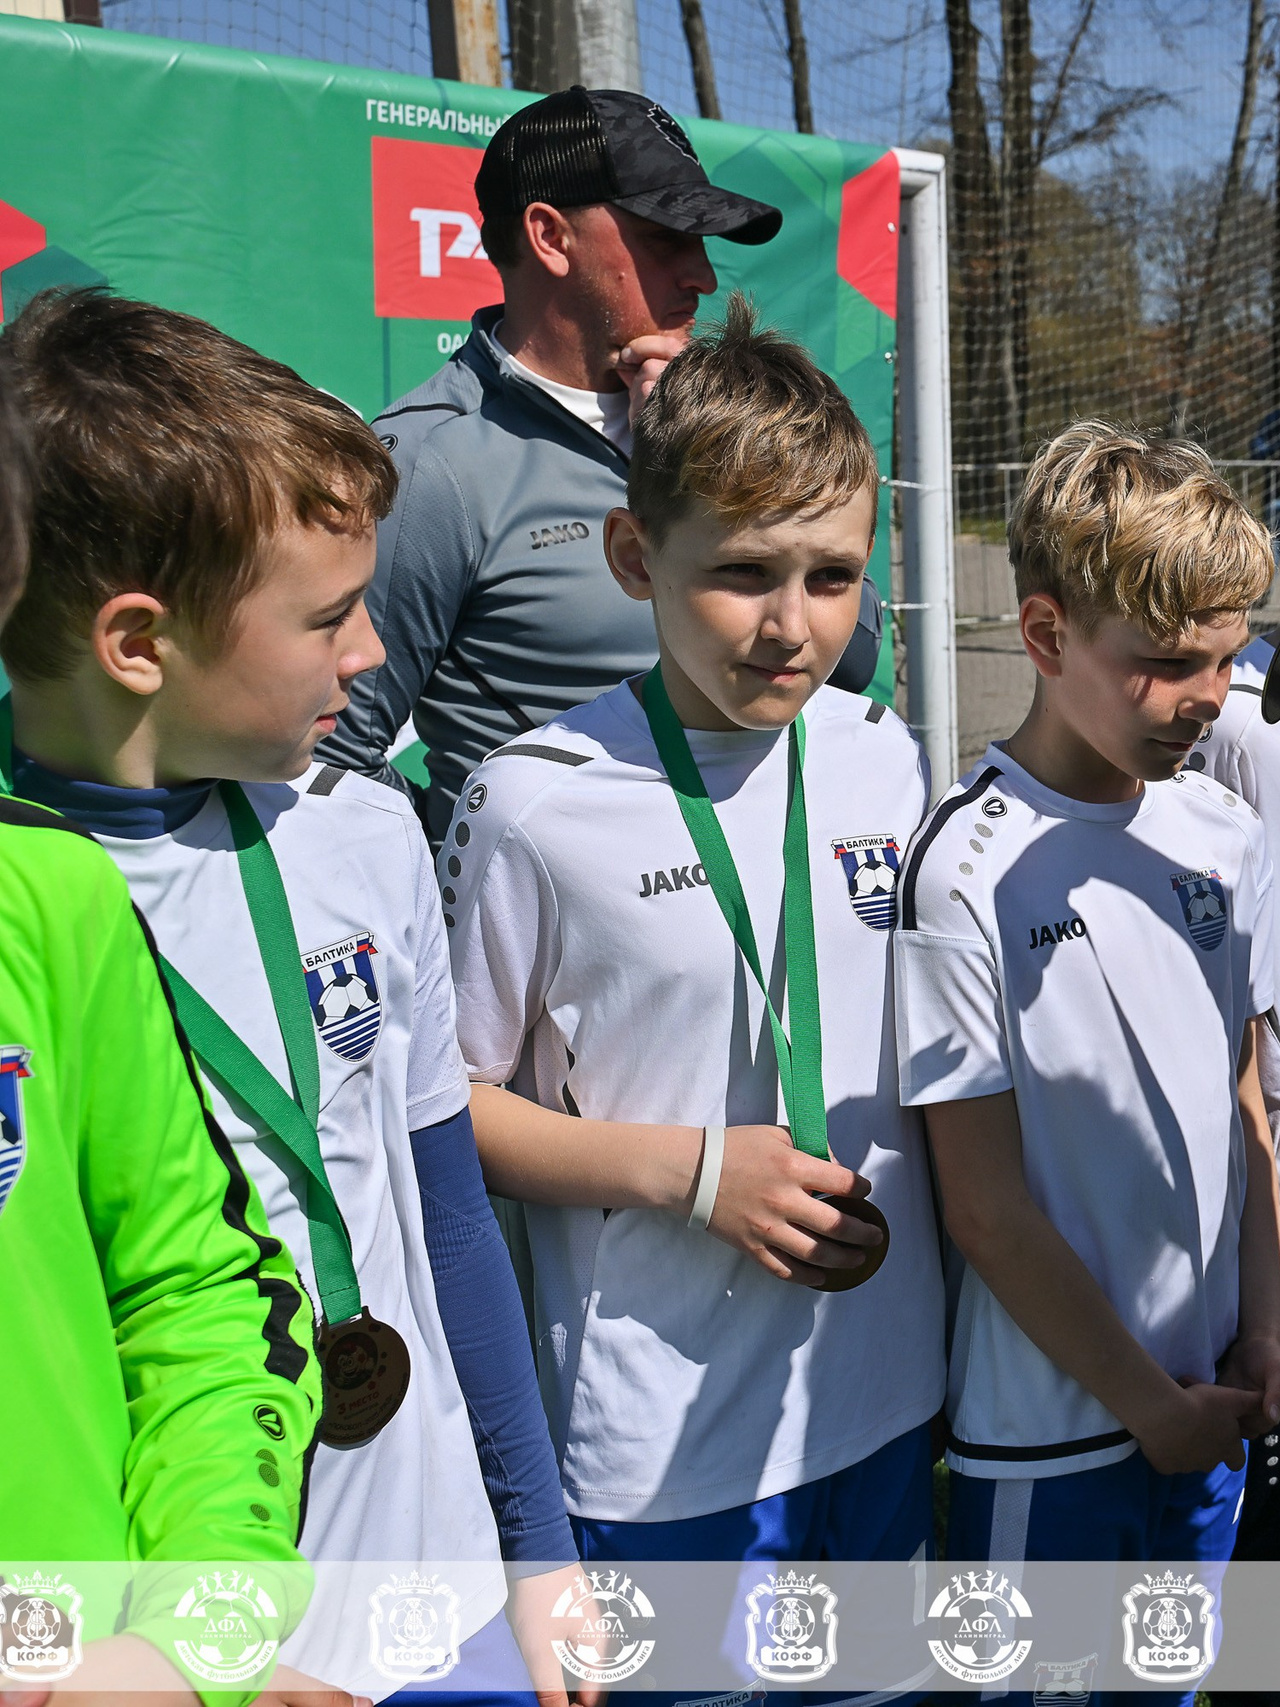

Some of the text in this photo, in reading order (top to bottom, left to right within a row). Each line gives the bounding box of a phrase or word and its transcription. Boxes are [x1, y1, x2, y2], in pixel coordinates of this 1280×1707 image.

[530, 521, 590, 550] JAKO
[846, 837, 885, 850] БАЛТИКА
[1178, 869, 1210, 883] БАЛТИКА
[1029, 917, 1087, 950] JAKO
[305, 941, 356, 968] БАЛТИКА
